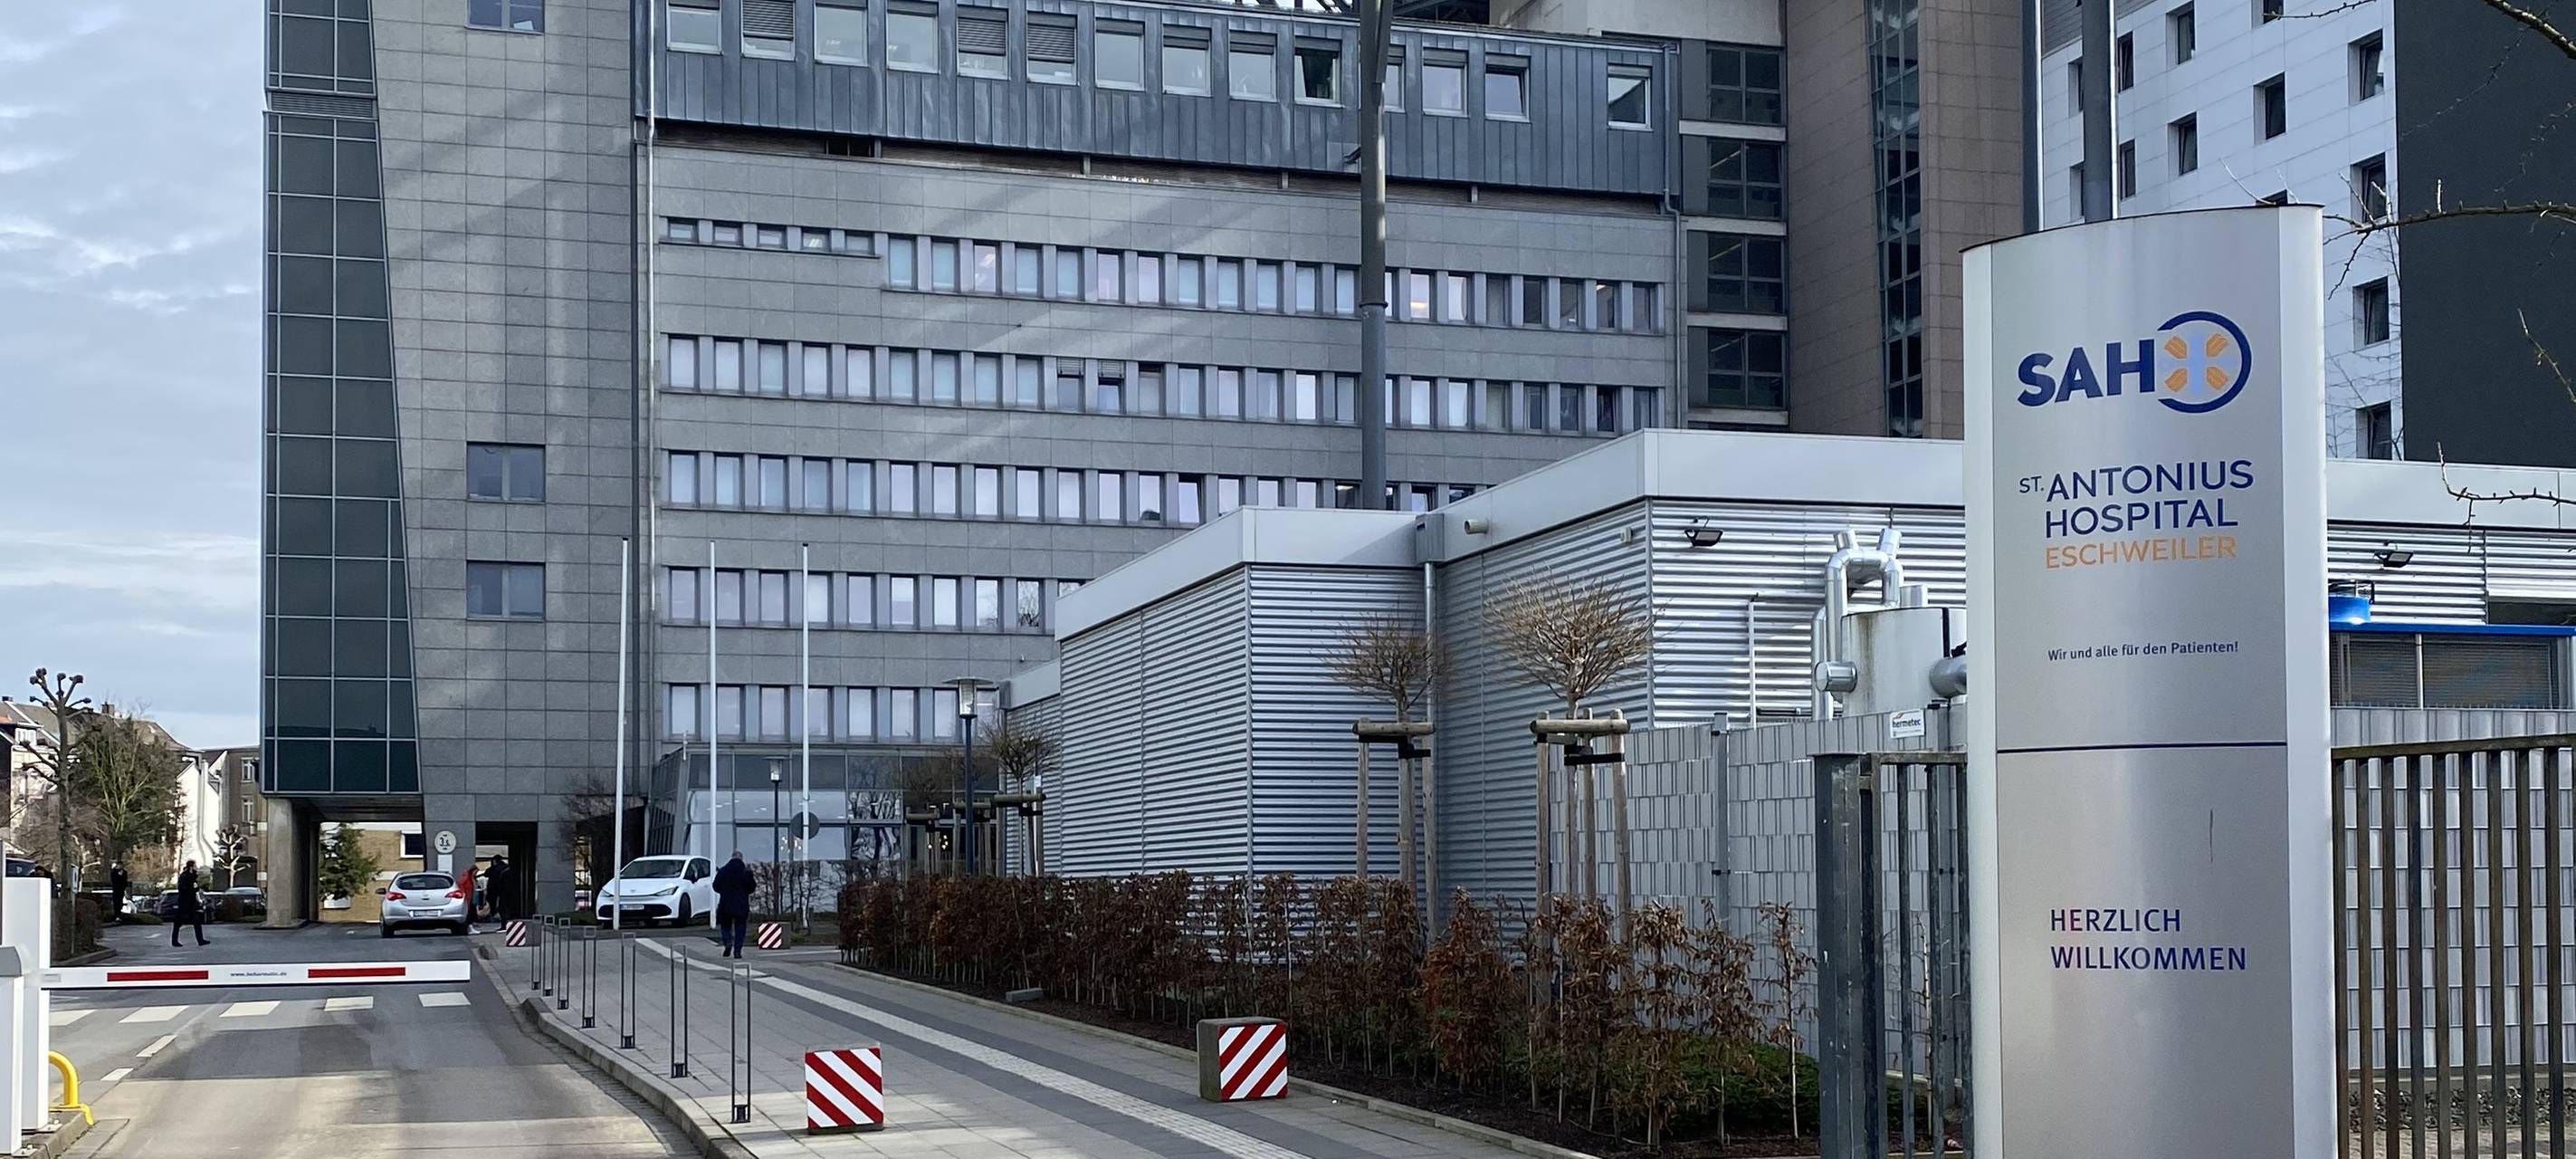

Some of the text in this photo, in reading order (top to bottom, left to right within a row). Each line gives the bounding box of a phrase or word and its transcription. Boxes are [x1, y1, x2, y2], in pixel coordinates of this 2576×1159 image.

[2018, 339, 2155, 407] SAH
[2019, 460, 2254, 502] ST. ANTONIUS
[2046, 498, 2238, 538] HOSPITAL
[2046, 535, 2237, 569] ESCHWEILER
[2047, 641, 2238, 662] Wir und alle für den Patienten!
[2050, 909, 2180, 932] HERZLICH
[2050, 946, 2246, 970] WILLKOMMEN
